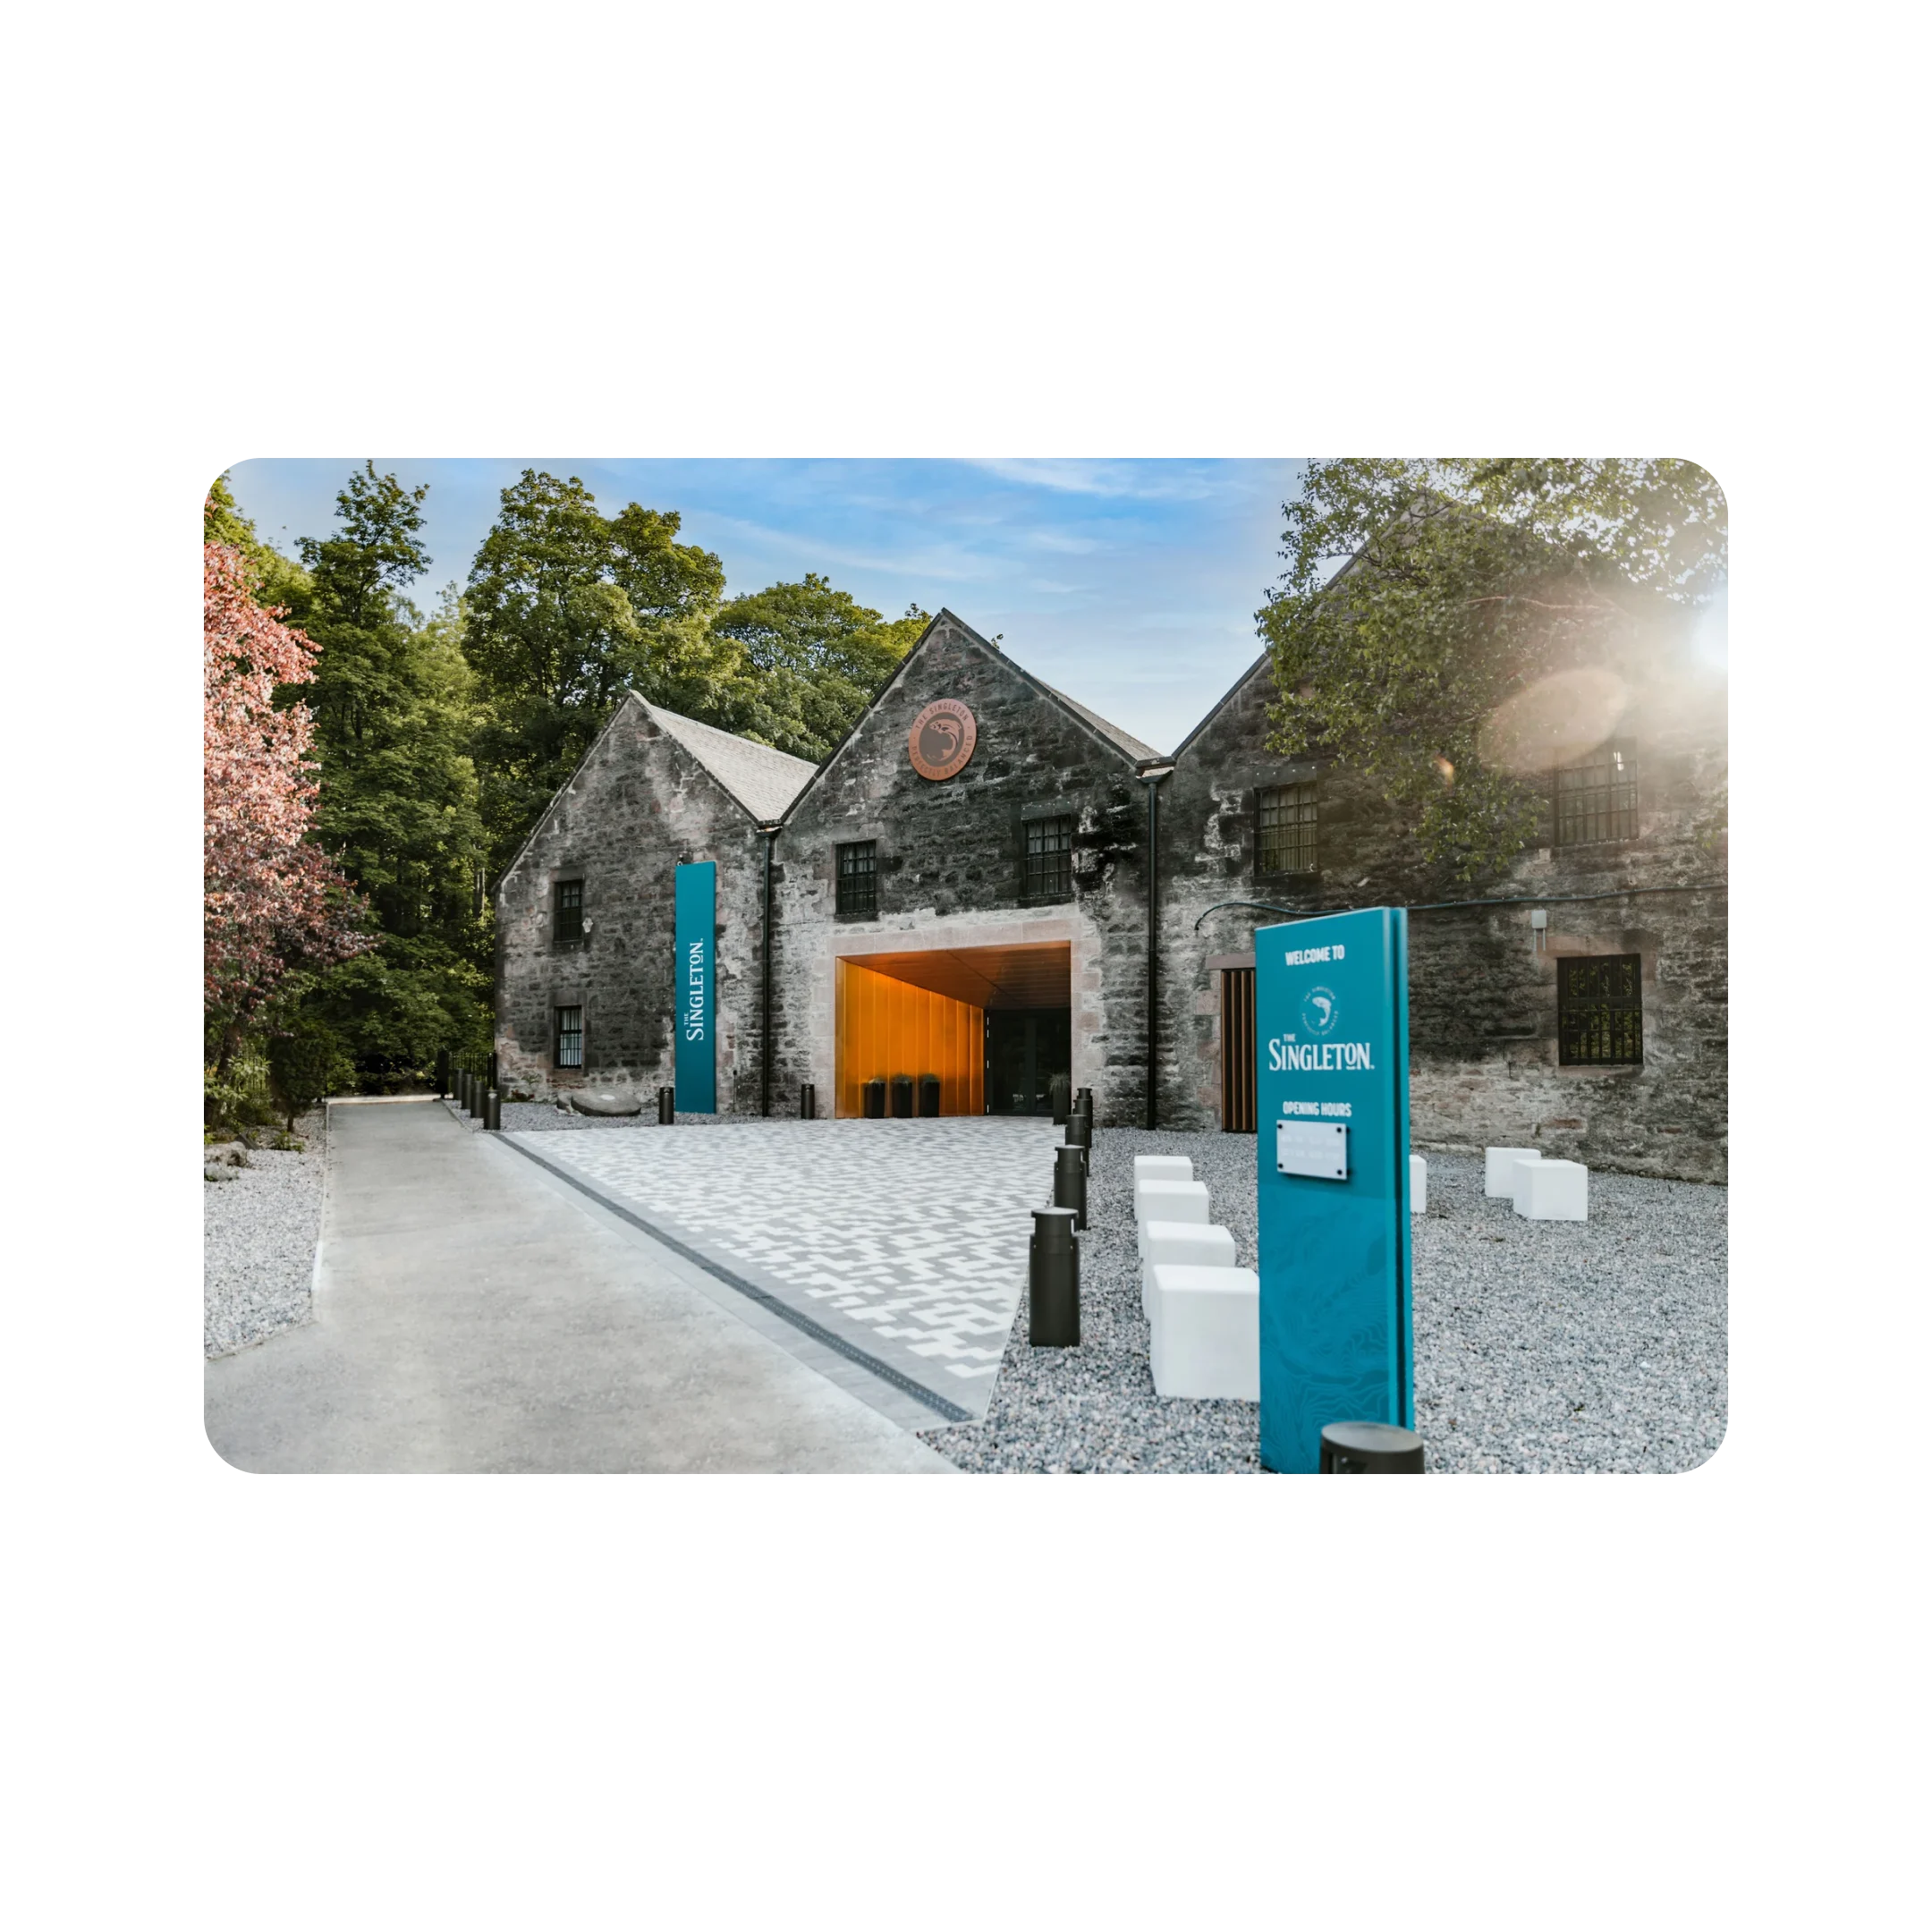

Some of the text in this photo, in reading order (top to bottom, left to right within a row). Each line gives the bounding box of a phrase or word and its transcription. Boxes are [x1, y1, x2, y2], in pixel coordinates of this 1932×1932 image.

[915, 702, 969, 729] THE SINGLETON
[945, 735, 973, 775] BALANCED
[1285, 944, 1345, 966] WELCOME TO
[1283, 1033, 1296, 1042] THE
[1282, 1101, 1352, 1117] OPENING HOURS
